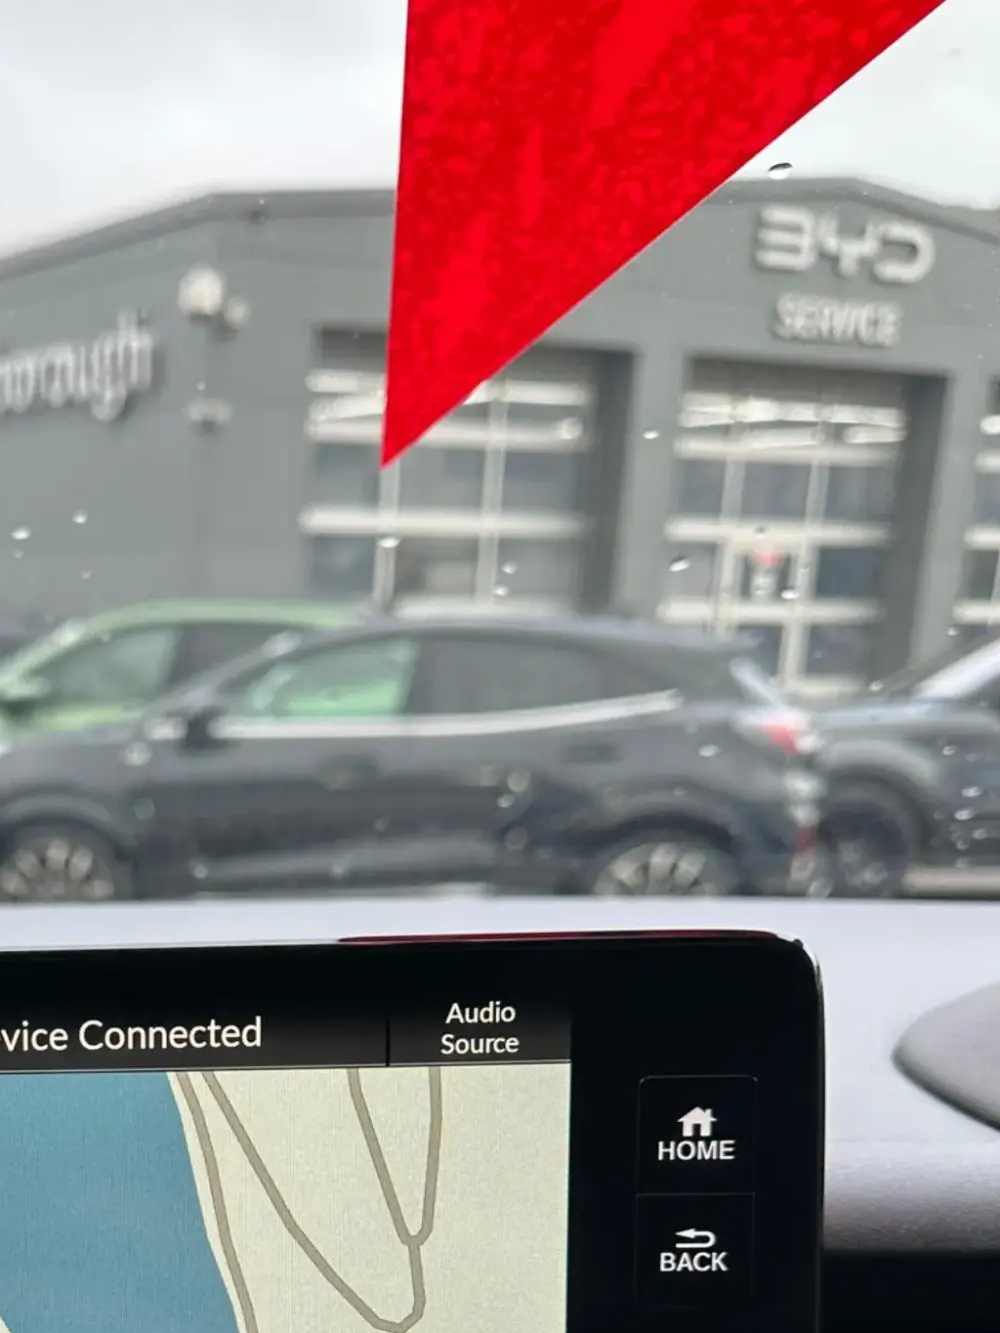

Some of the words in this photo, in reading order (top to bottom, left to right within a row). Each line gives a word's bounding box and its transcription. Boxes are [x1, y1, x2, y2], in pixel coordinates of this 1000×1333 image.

[445, 1000, 516, 1024] Audio
[78, 1015, 262, 1051] Connected
[440, 1033, 520, 1055] Source
[657, 1139, 735, 1161] HOME
[659, 1251, 728, 1272] BACK
